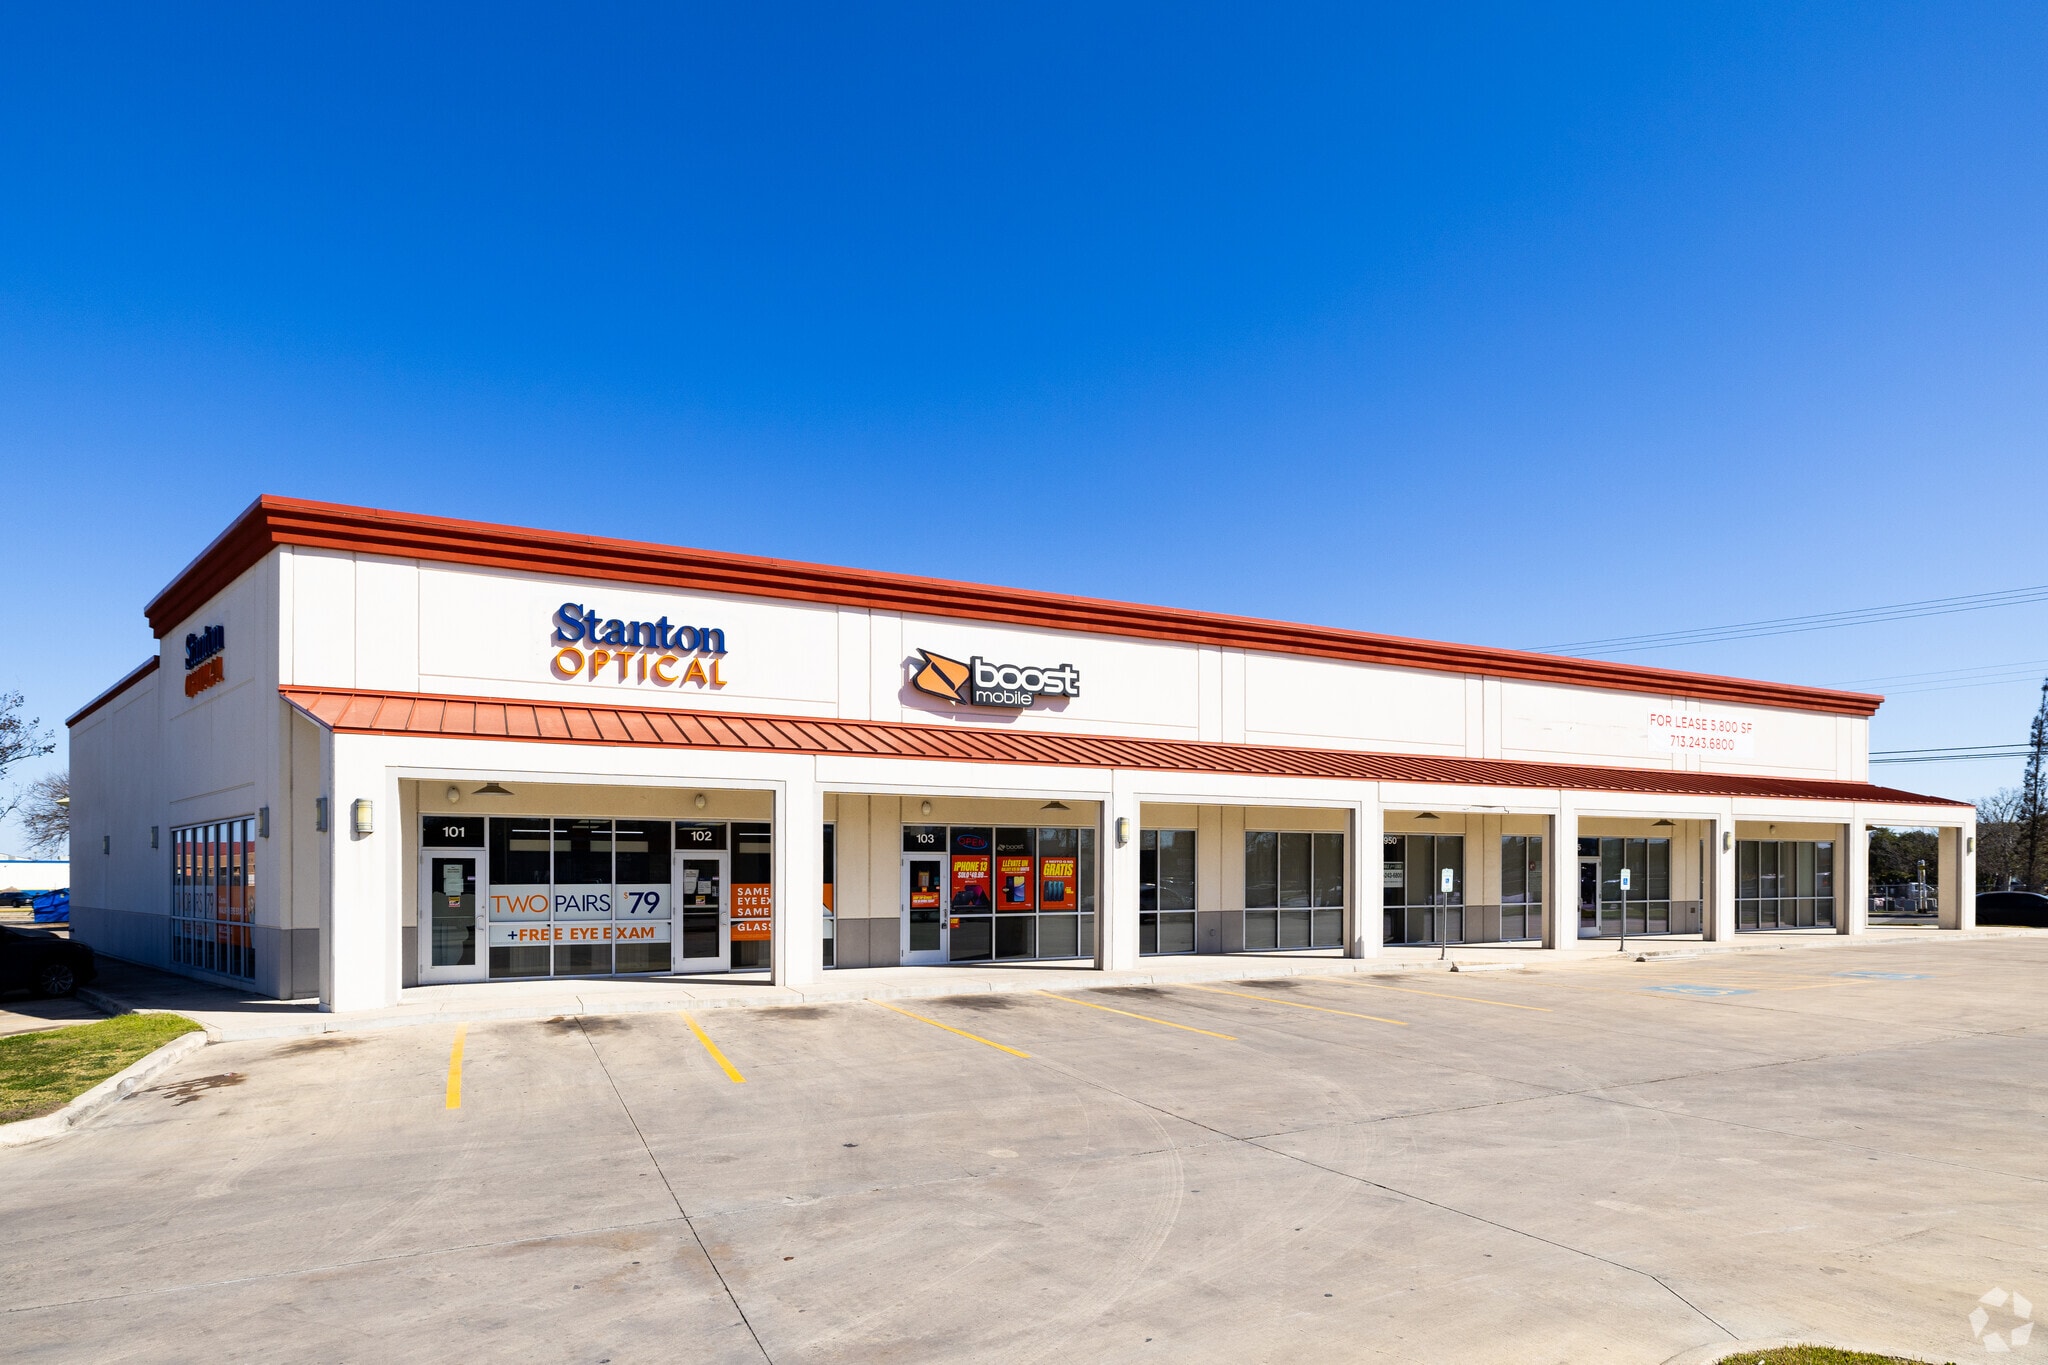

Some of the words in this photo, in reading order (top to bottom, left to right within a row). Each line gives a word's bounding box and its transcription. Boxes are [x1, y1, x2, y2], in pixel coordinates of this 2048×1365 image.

[557, 602, 728, 654] Stanton
[556, 646, 728, 685] OPTICAL
[975, 658, 1078, 694] boost
[975, 690, 1032, 705] mobile
[1650, 713, 1672, 727] FOR
[1675, 716, 1708, 731] LEASE
[1741, 722, 1753, 734] SF
[1670, 734, 1735, 751] 713.243.6800
[442, 826, 465, 838] 101
[691, 831, 713, 841] 102
[916, 833, 935, 844] 103
[959, 838, 985, 847] OPEN
[953, 861, 980, 872] iPHONE
[980, 861, 988, 872] 13
[1043, 863, 1074, 876] GRATIS
[737, 887, 770, 896] SAME
[490, 894, 549, 913] TWO
[555, 893, 611, 912] PAIRS
[623, 891, 660, 914] $79
[737, 897, 758, 905] EYE
[737, 907, 770, 916] SAME
[570, 927, 599, 940] EYE
[603, 926, 655, 940] EXAM
